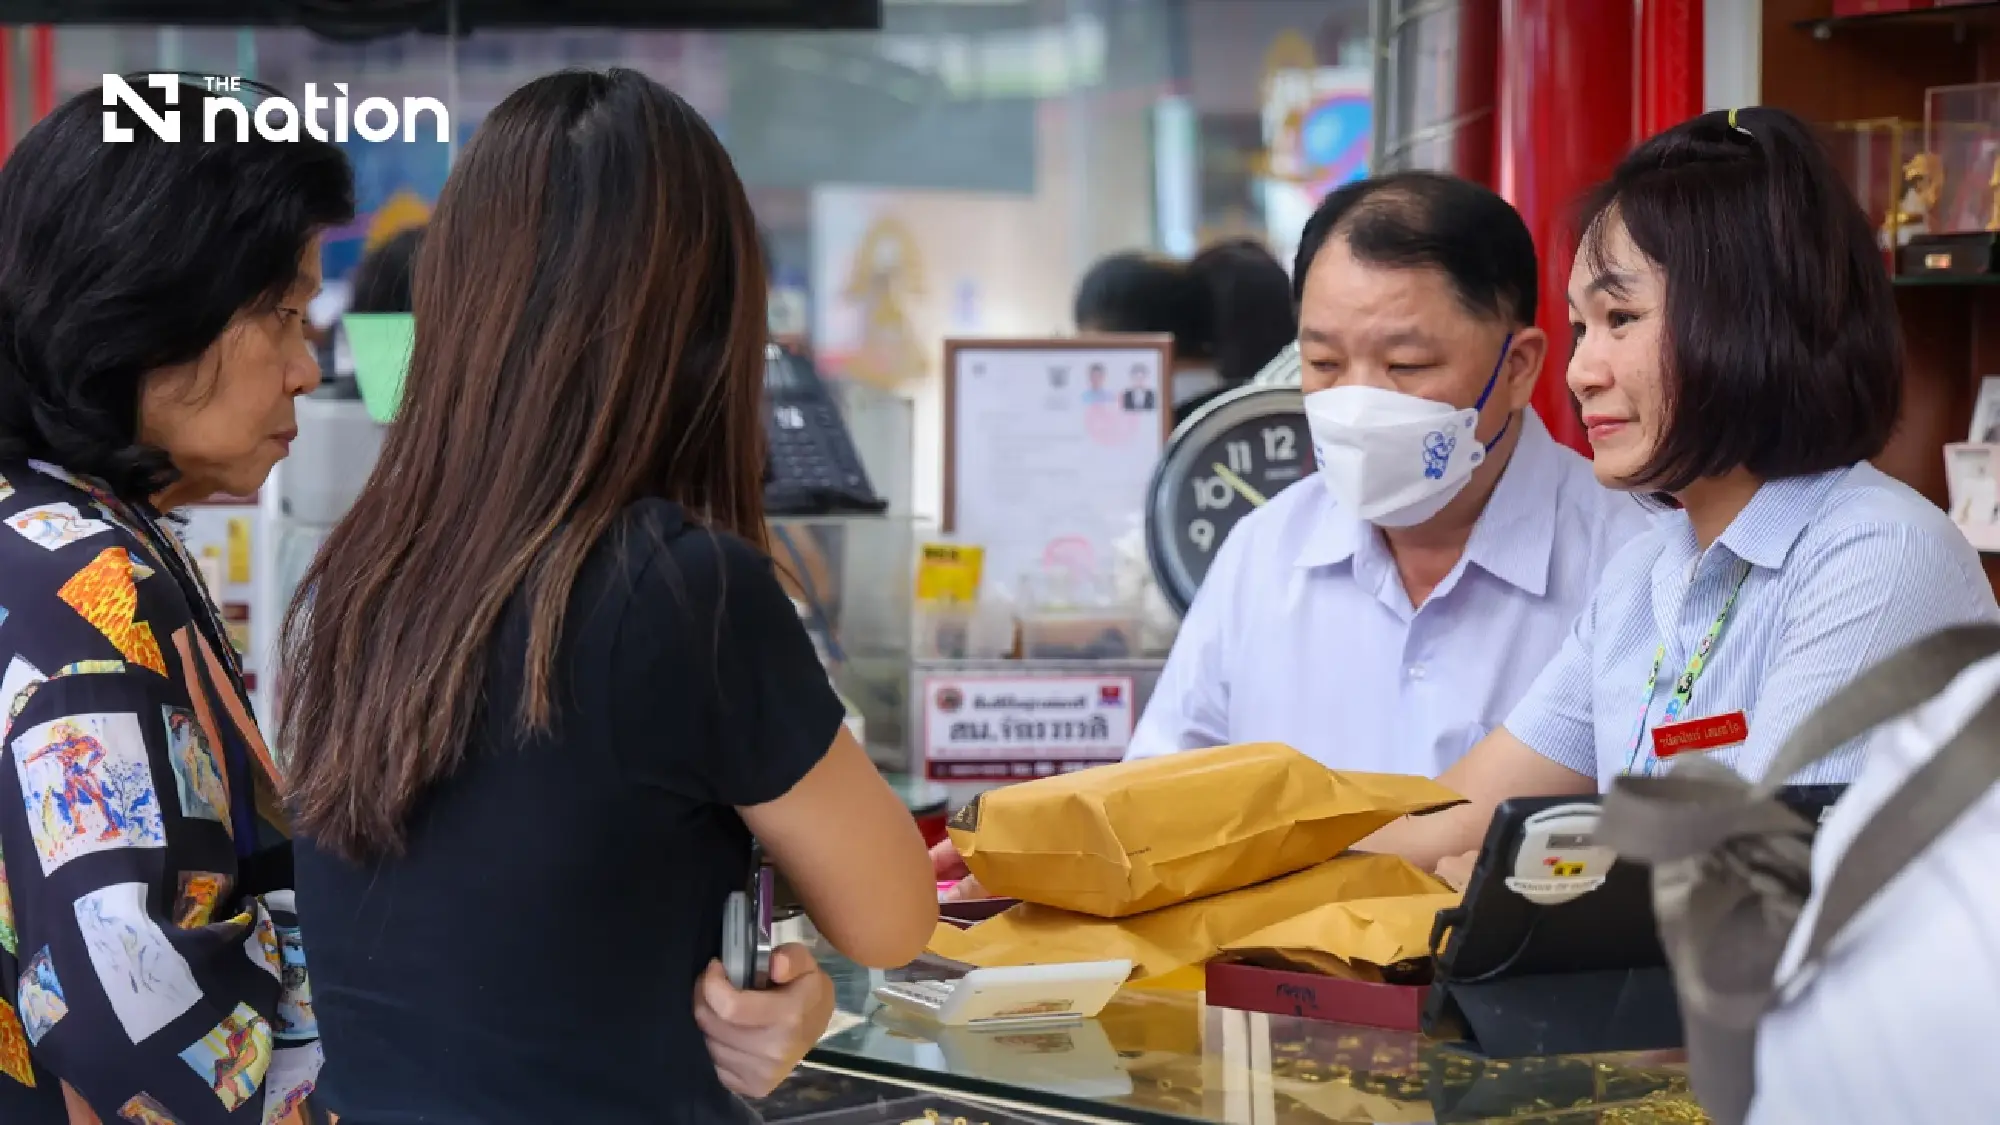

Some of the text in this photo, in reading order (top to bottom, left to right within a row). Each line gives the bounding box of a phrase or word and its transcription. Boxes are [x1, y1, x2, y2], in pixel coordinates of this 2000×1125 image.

[1226, 440, 1252, 473] 11
[1262, 426, 1297, 460] 12
[1192, 476, 1234, 510] 10
[1188, 518, 1215, 551] 9
